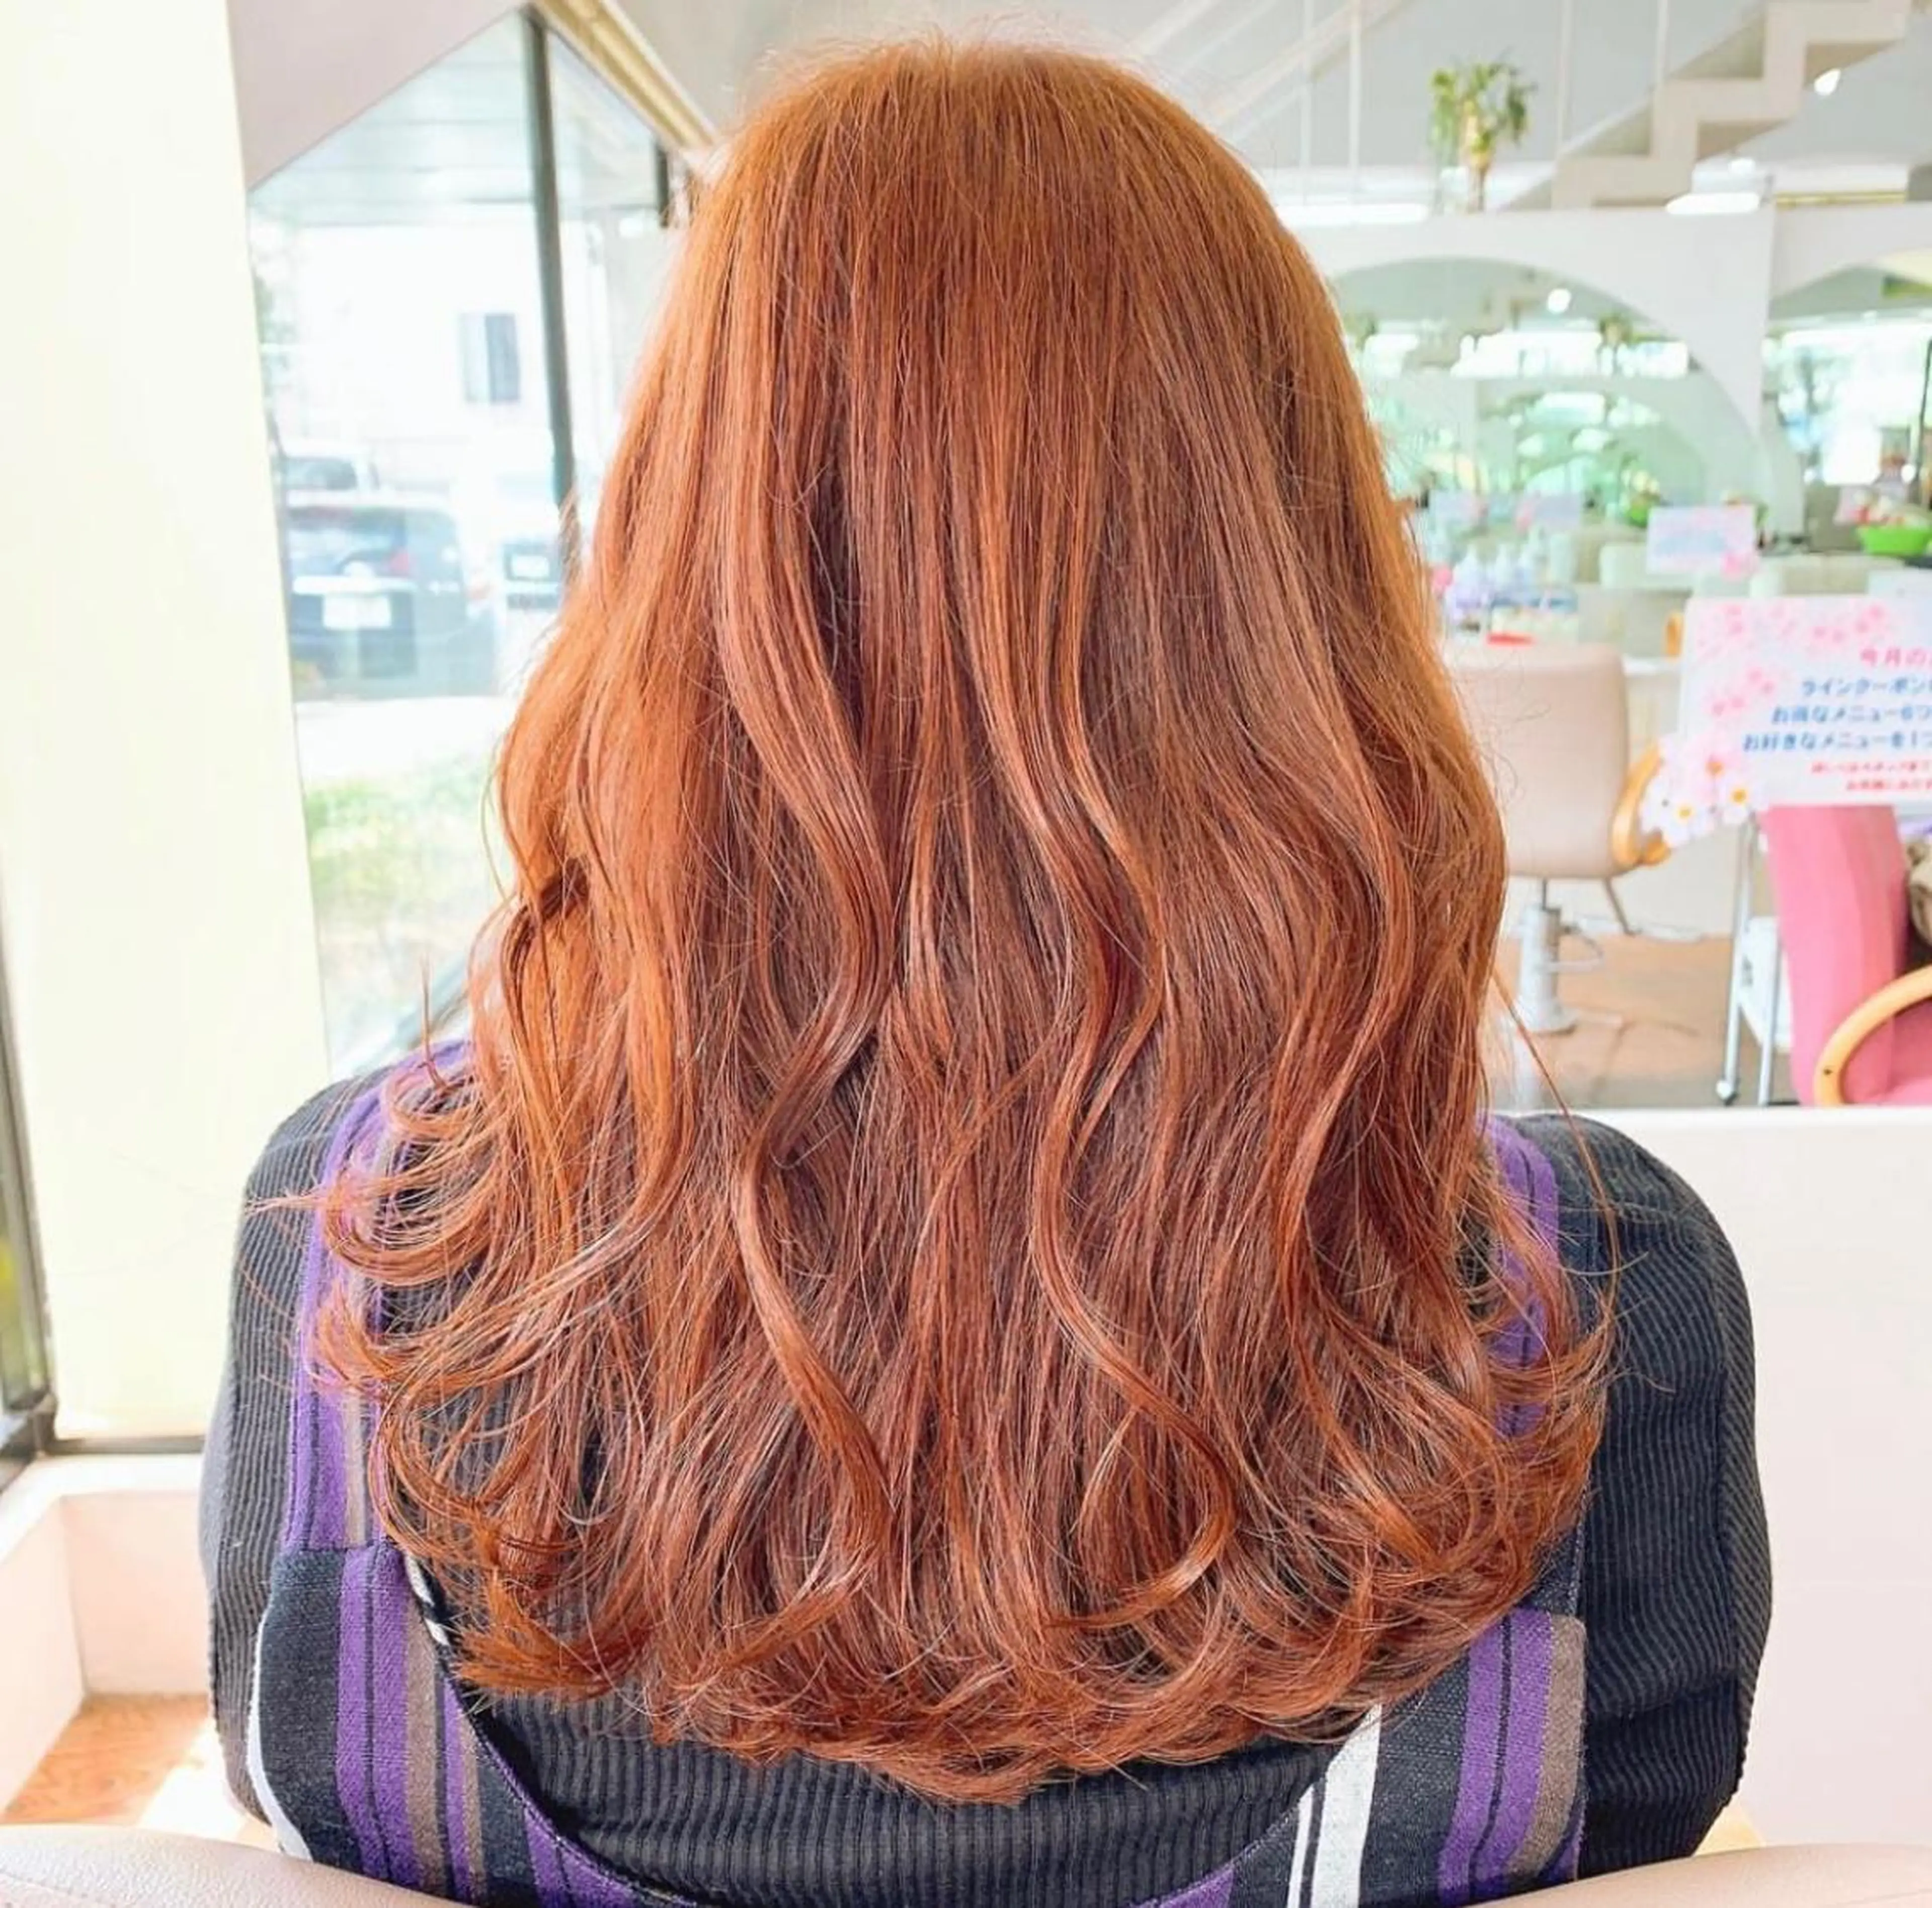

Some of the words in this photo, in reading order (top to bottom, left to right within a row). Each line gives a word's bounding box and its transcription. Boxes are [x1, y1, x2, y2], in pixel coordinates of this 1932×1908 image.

[1860, 647, 1932, 668] 今月の
[1802, 676, 1932, 696] ラインクーポン
